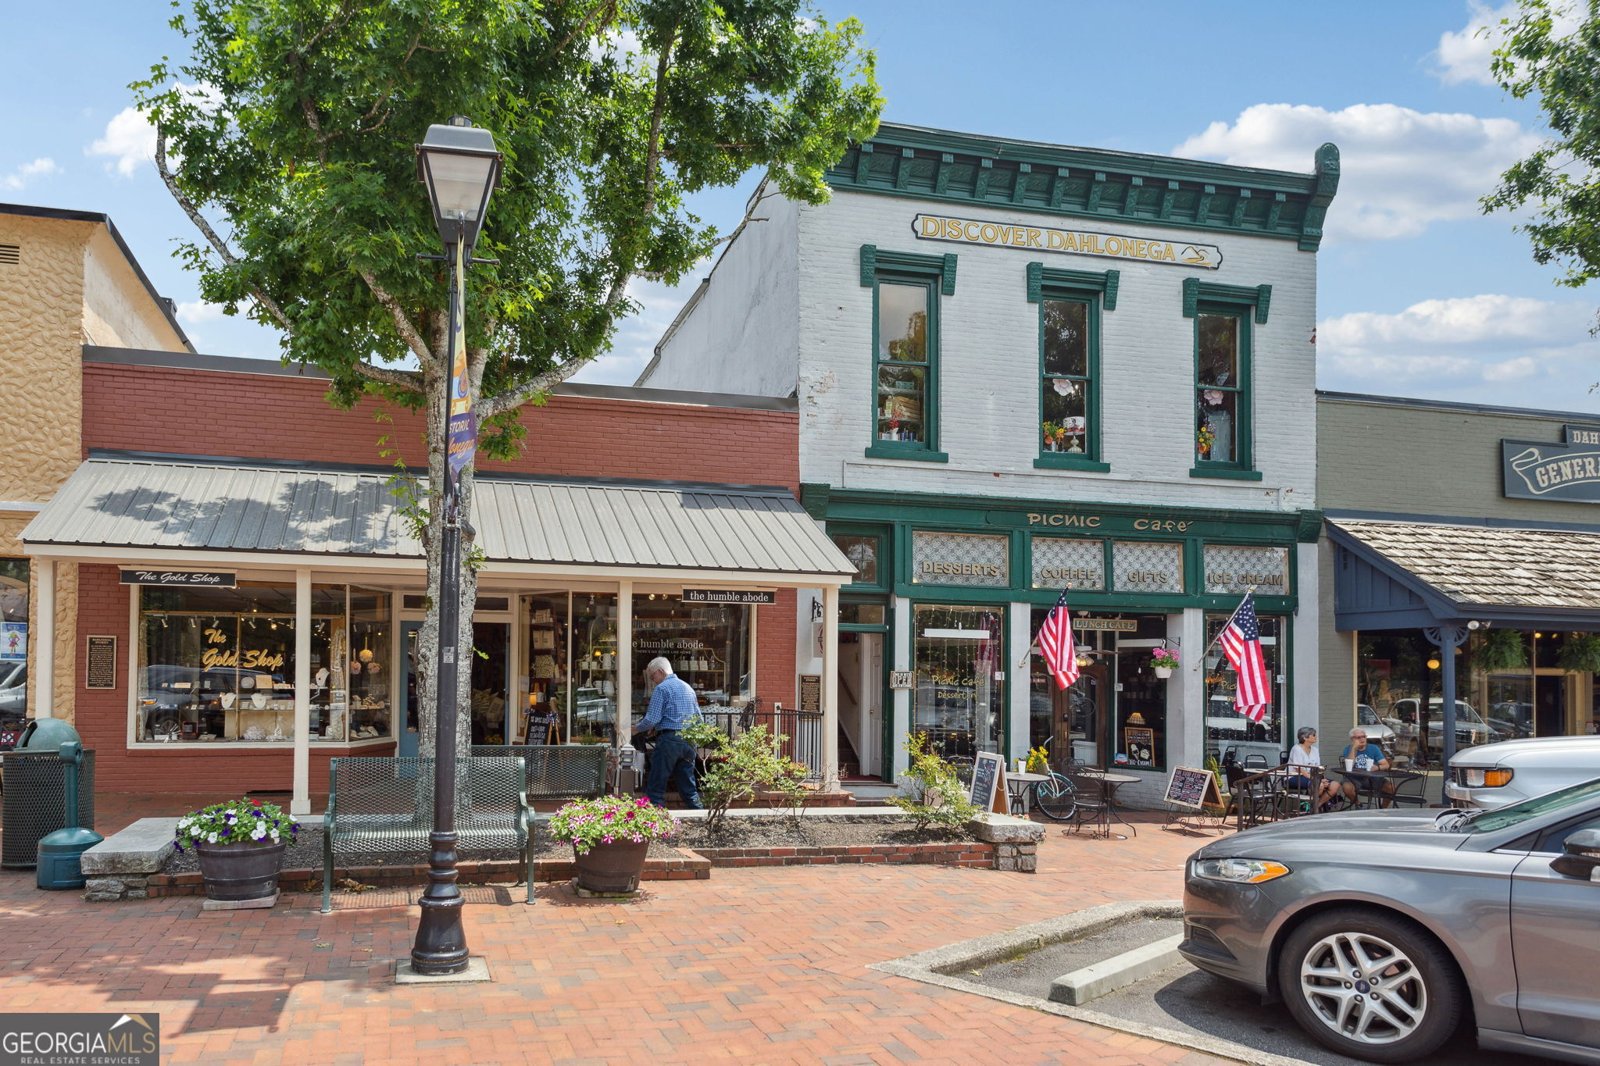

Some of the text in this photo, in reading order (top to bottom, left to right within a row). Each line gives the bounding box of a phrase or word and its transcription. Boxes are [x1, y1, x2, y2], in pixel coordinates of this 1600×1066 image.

[921, 216, 1176, 261] DISCOVER DAHLONEGA
[1573, 430, 1600, 444] DAH
[1027, 513, 1101, 528] PICNIC
[922, 560, 1000, 577] DESSERTS
[1040, 567, 1096, 580] COFFEE
[135, 571, 220, 584] The Gold Shop
[1127, 571, 1168, 584] GIFTS
[1208, 572, 1284, 586] ICE CREAM
[690, 590, 768, 602] the humble abode
[1076, 620, 1107, 629] LUNCH
[204, 628, 227, 644] The
[640, 638, 675, 649] humble
[676, 640, 704, 649] abode
[202, 647, 283, 672] Gold Shop
